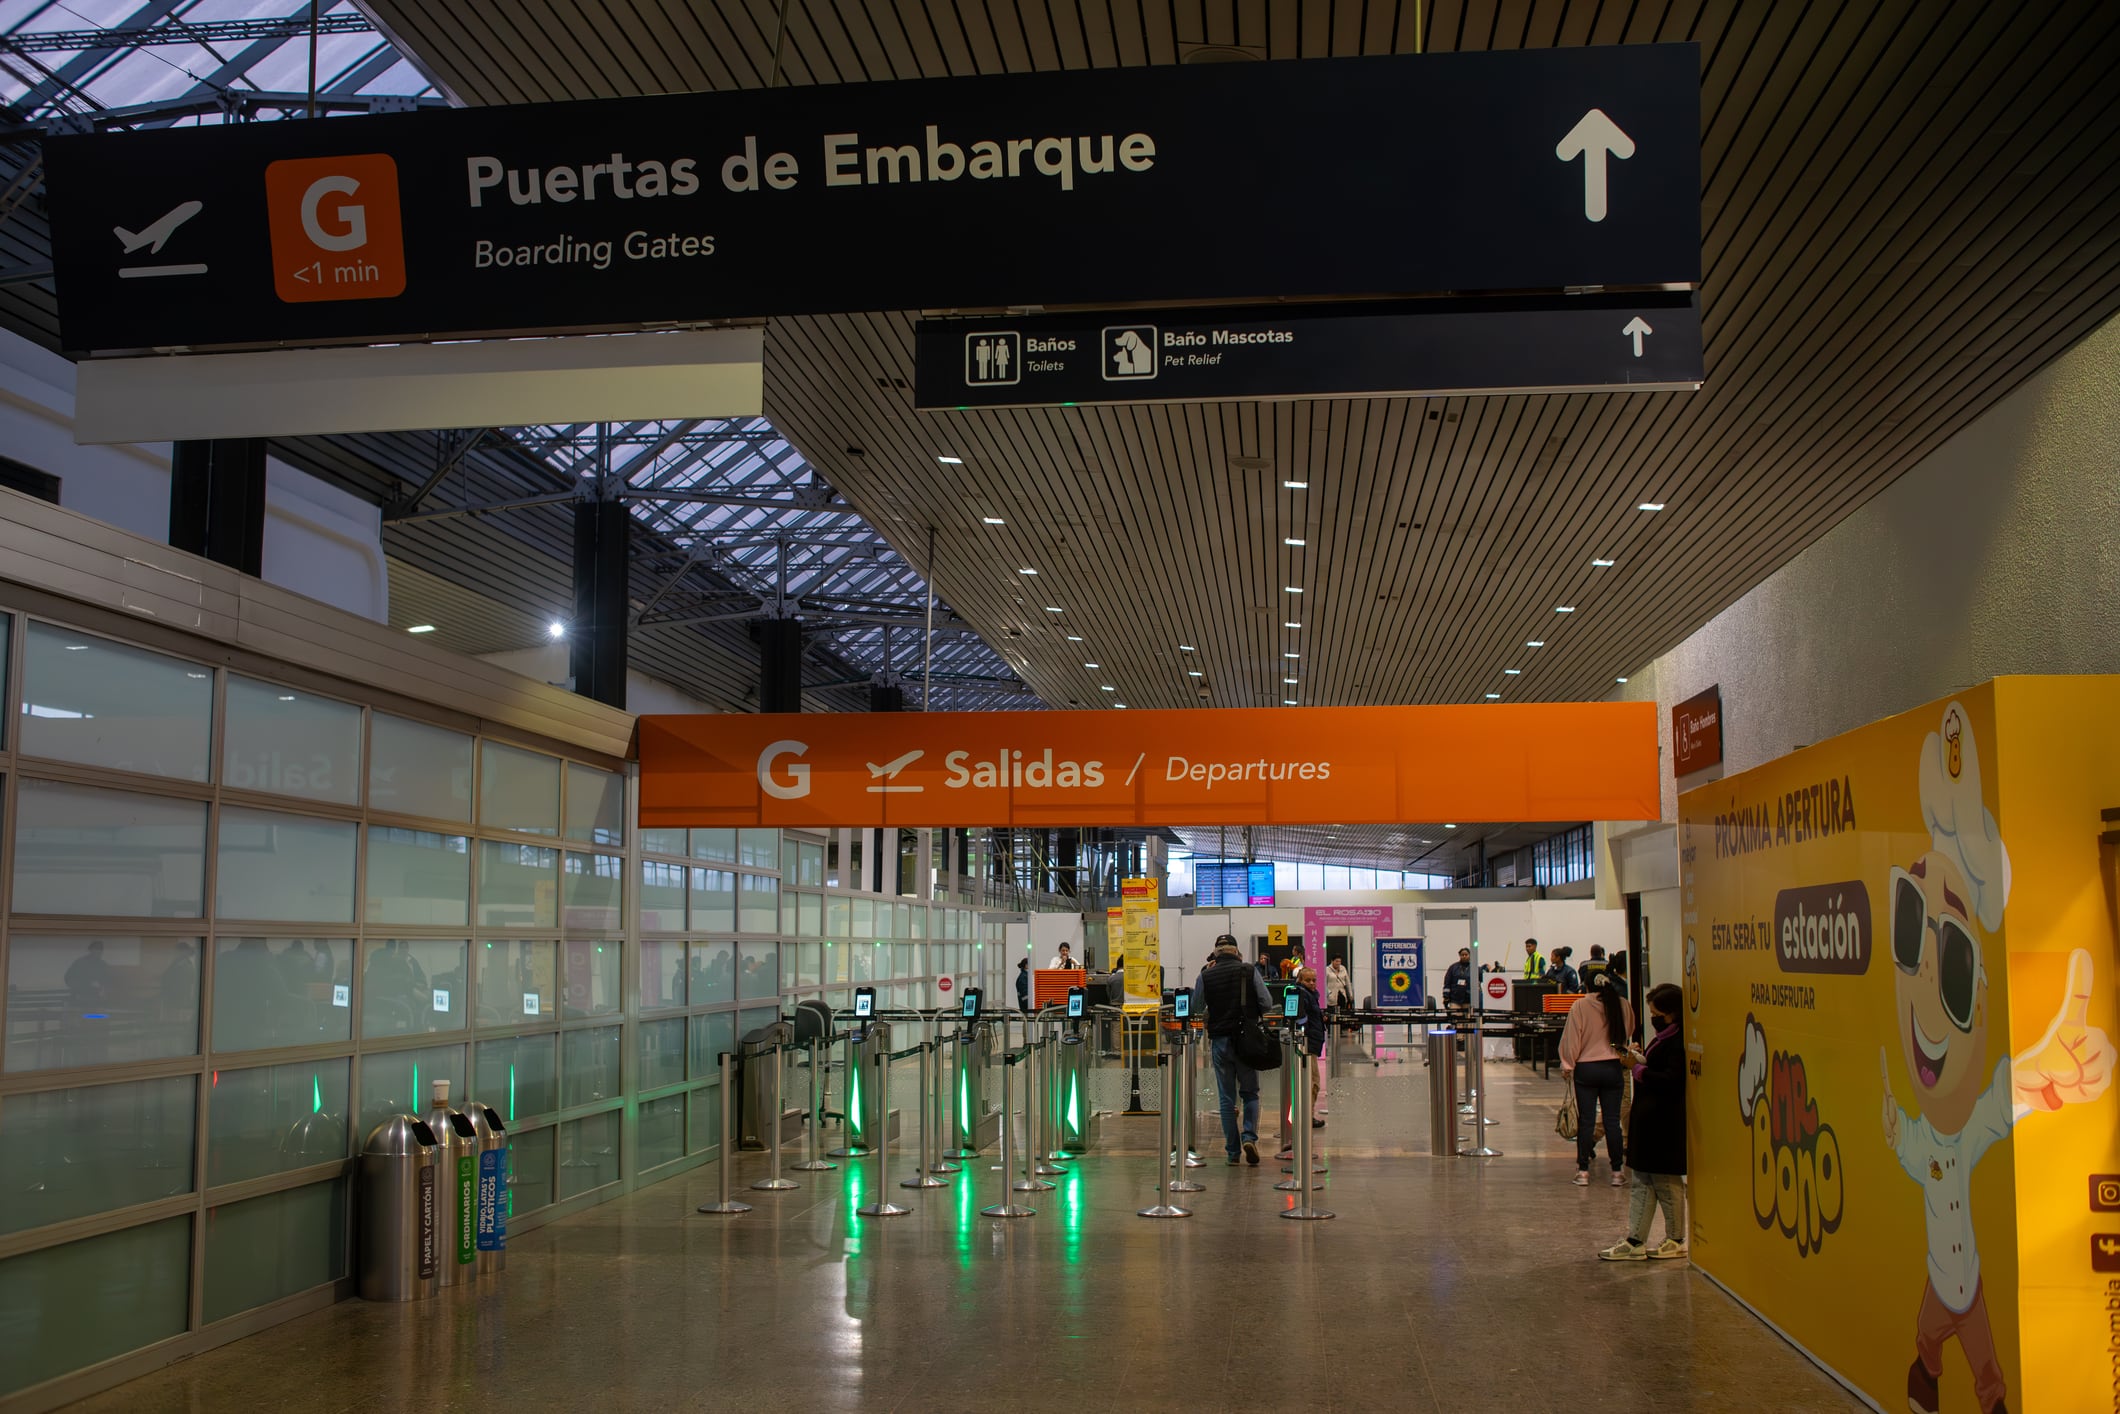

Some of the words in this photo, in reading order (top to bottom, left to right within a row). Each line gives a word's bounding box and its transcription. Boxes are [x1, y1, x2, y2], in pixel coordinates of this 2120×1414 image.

[468, 152, 699, 208] Puertas
[722, 135, 799, 193] de
[823, 125, 1156, 191] Embarque
[300, 175, 368, 252] G
[475, 233, 613, 270] Boarding
[624, 230, 715, 260] Gates
[293, 261, 323, 284] <1
[334, 258, 379, 284] min
[1026, 335, 1077, 353] Baños
[1163, 330, 1207, 347] Baño
[1212, 328, 1294, 345] Mascotas
[1027, 359, 1065, 373] Toilets
[1164, 354, 1185, 367] Pet
[1187, 352, 1222, 367] Relief
[756, 740, 811, 800] G
[944, 748, 1105, 789] Salidas
[1166, 756, 1331, 790] Departures
[1715, 796, 1772, 859] PRÓXIMA
[1775, 775, 1856, 847] APERTURA
[1274, 930, 1283, 941] 2
[1712, 917, 1732, 950] ÉSTA
[1733, 915, 1757, 950] SERÁ
[1758, 921, 1771, 950] TU
[1782, 893, 1861, 960] estación
[1382, 942, 1417, 950] PREFERENCIAL
[1751, 982, 1771, 1005] PARA
[1771, 983, 1816, 1010] DISFRUTAR
[422, 1186, 432, 1226] CARTÓN
[463, 1180, 471, 1249] ORDINARIOS
[424, 1227, 432, 1236] Y
[424, 1235, 432, 1264] PAPEL
